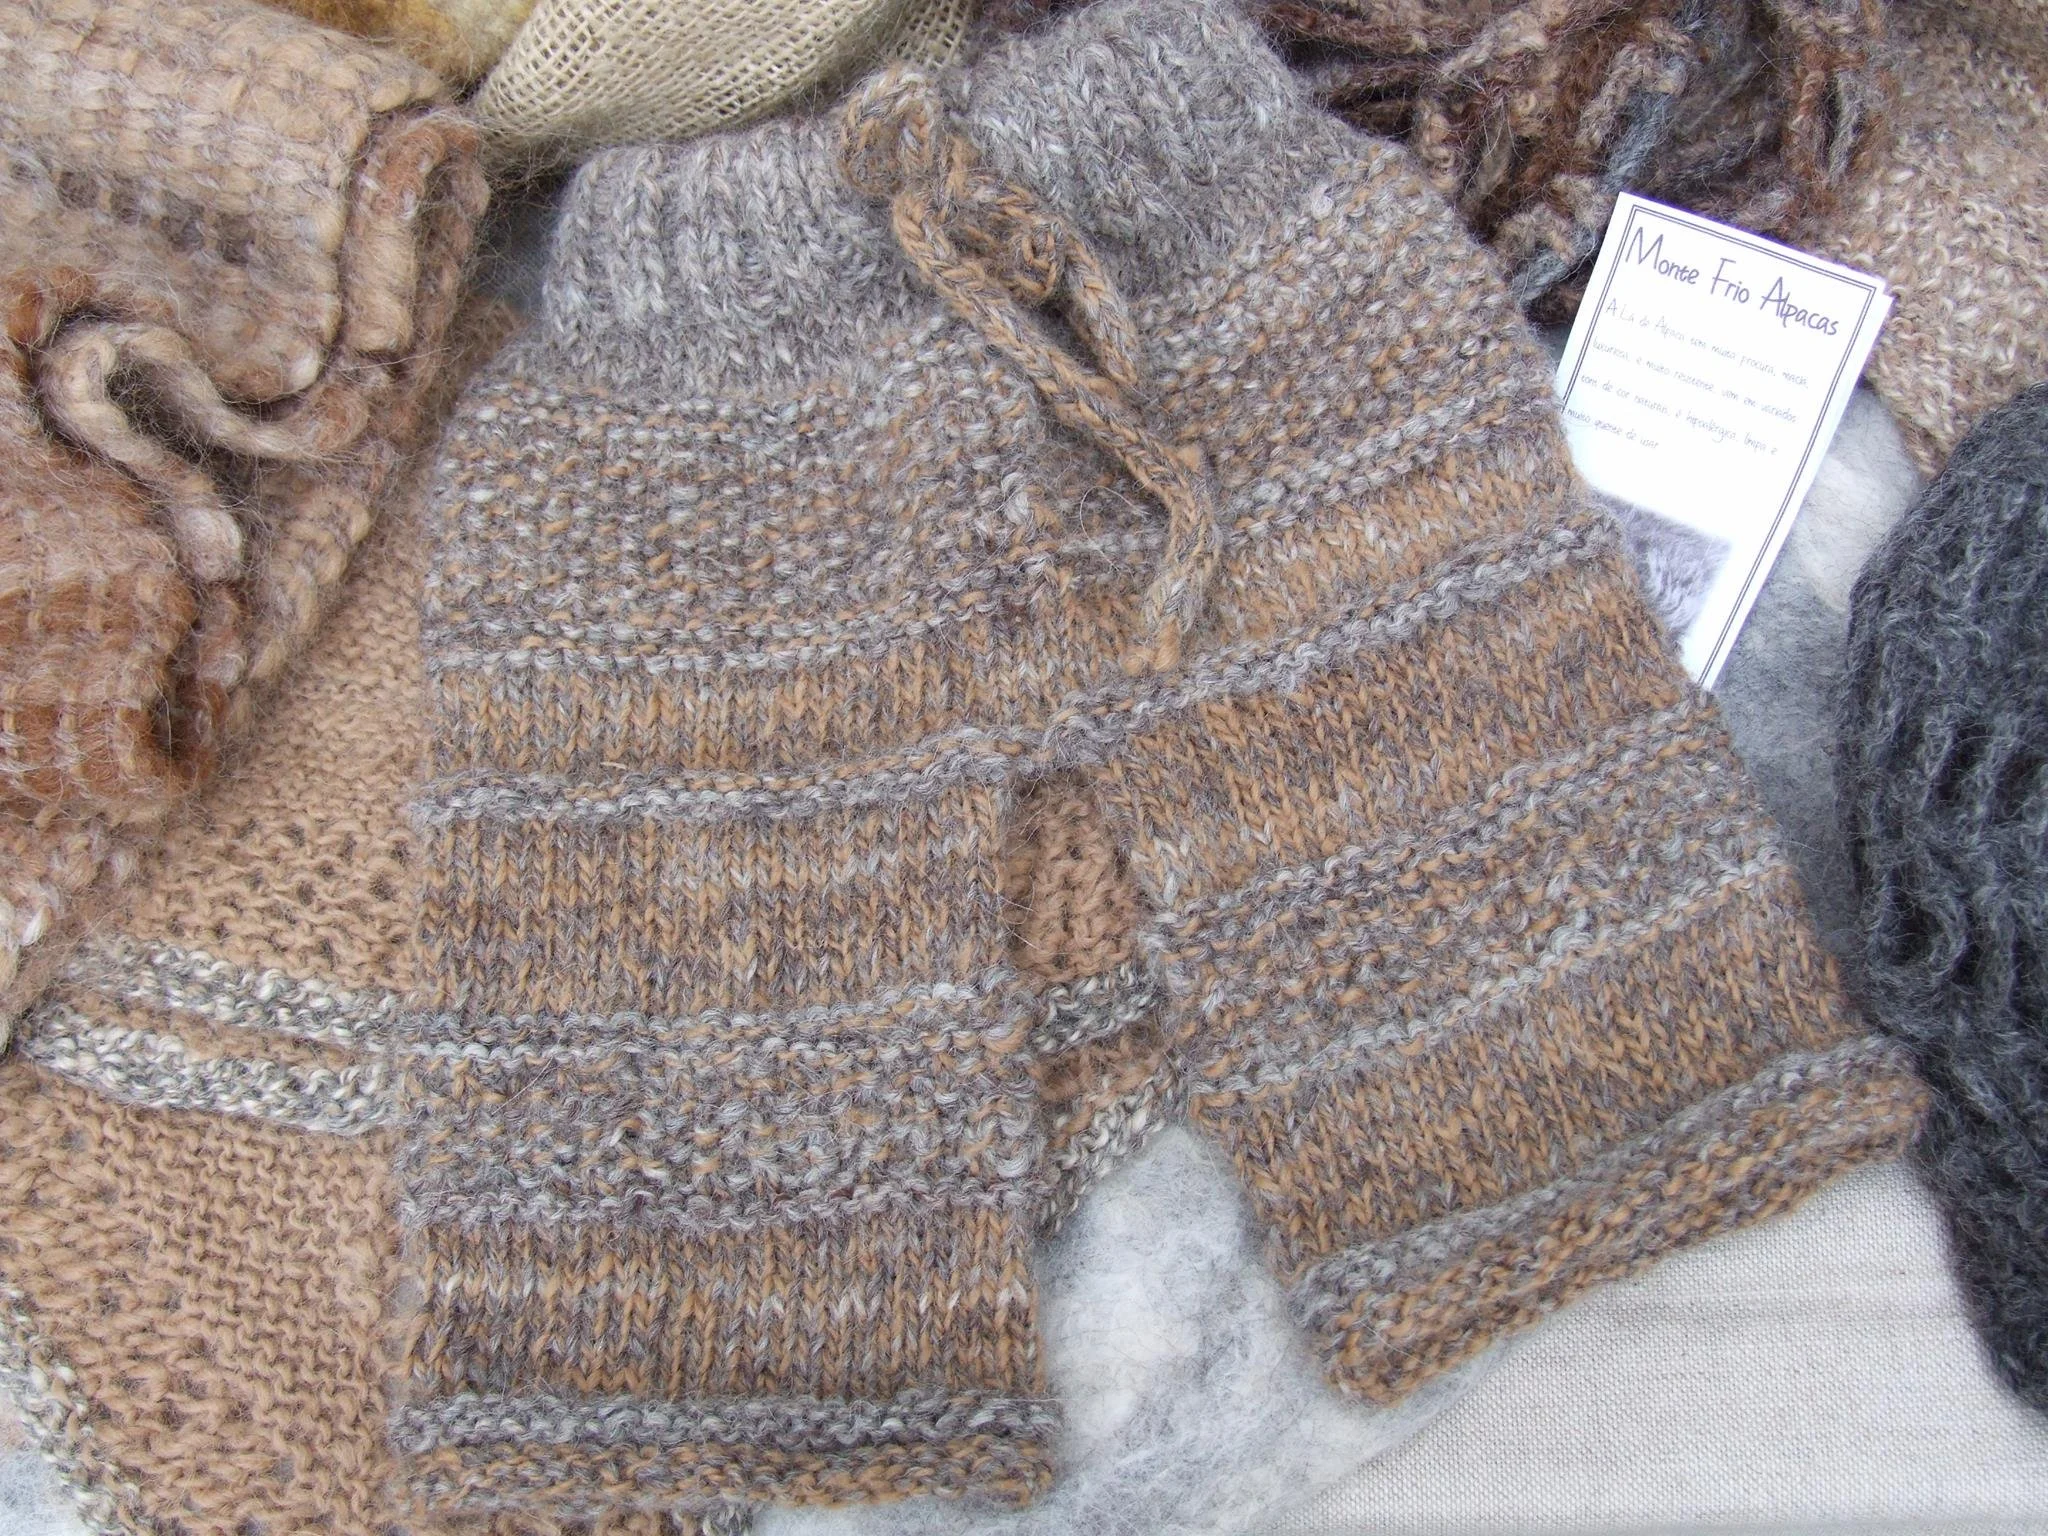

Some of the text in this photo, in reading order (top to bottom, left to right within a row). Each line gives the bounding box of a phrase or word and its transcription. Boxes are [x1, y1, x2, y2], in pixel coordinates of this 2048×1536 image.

[1625, 226, 1839, 336] Monte Frio Alpacas
[1605, 298, 1617, 317] A
[1654, 315, 1685, 342] Alpaca
